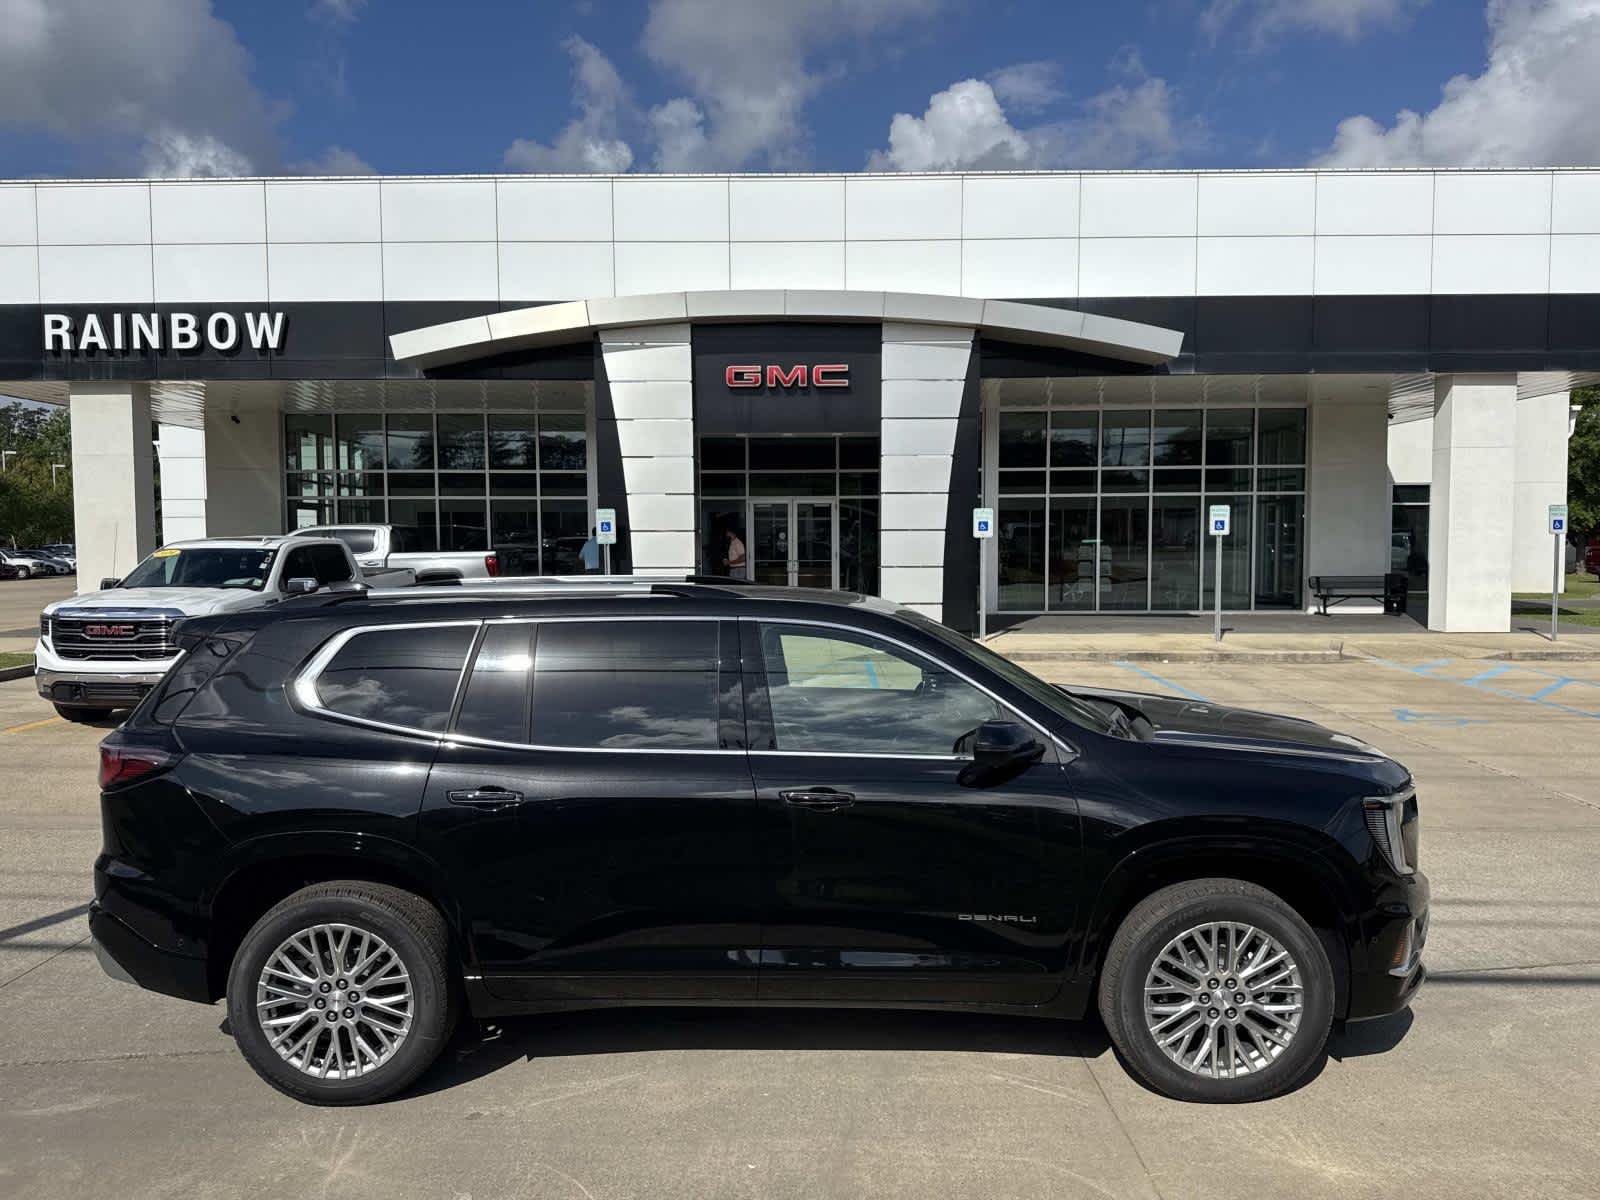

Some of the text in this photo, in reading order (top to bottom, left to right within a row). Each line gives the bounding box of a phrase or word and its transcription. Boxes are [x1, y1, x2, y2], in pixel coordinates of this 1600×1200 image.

[43, 311, 284, 351] RAINBOW
[725, 364, 849, 387] GMC
[84, 625, 136, 635] GMC
[957, 914, 1037, 923] DENALI
